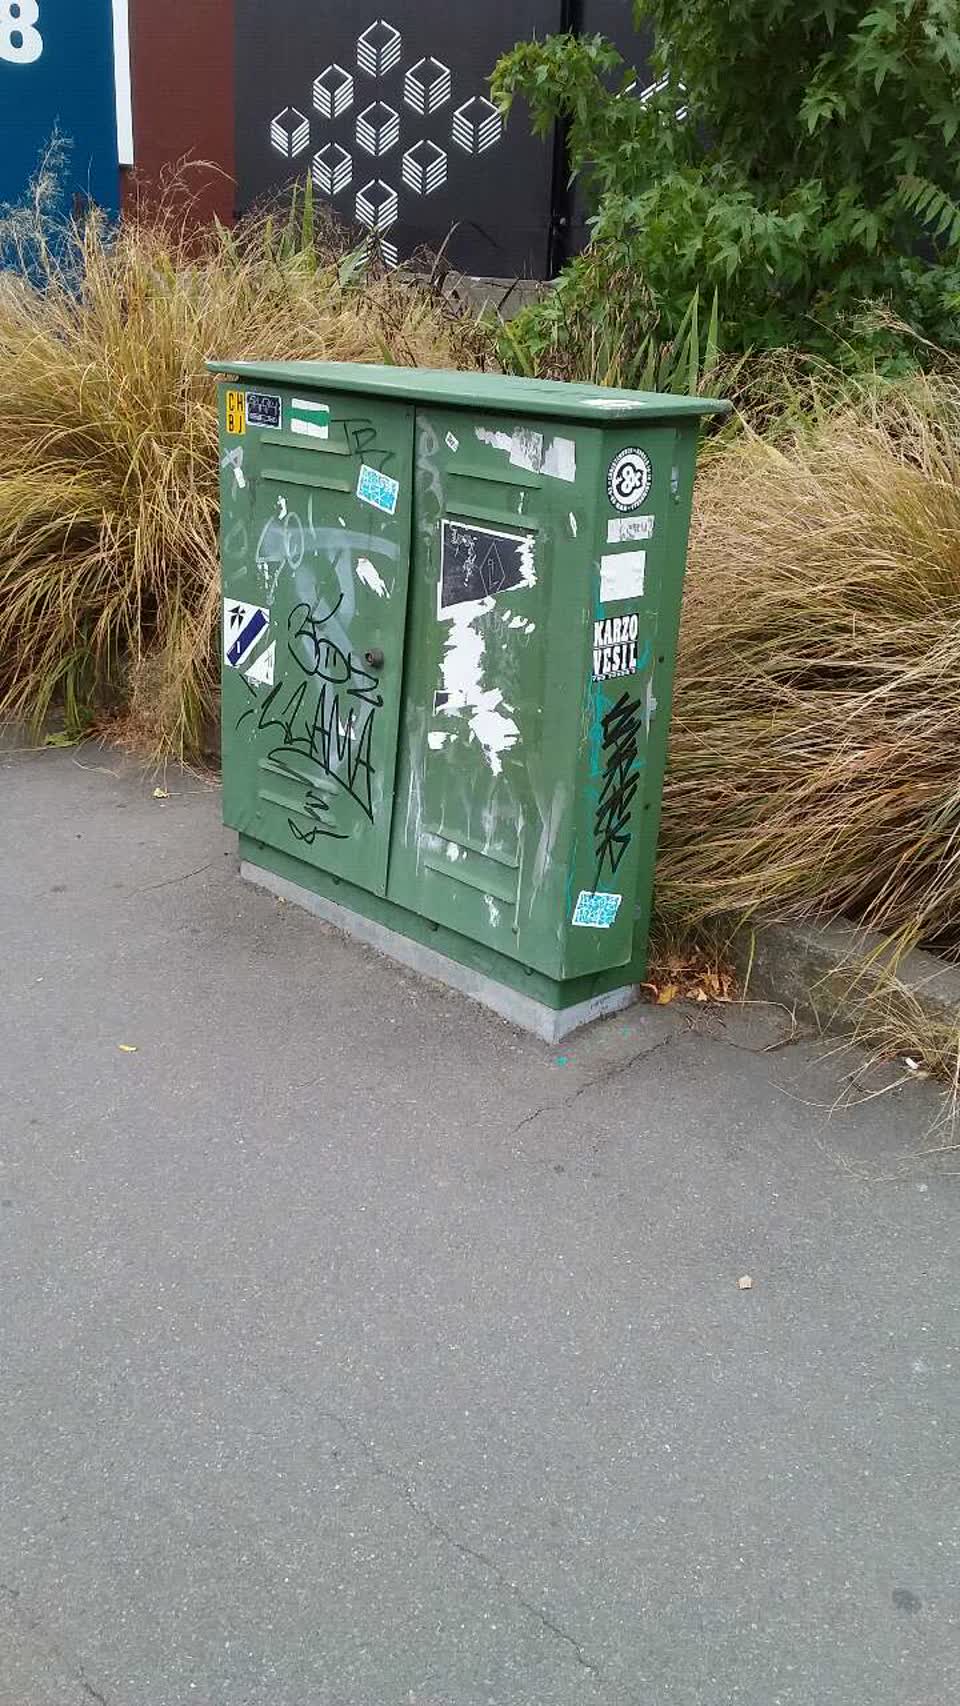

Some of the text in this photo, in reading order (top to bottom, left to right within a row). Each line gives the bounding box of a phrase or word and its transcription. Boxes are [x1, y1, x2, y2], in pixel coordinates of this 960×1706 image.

[0, 0, 43, 64] 8
[228, 392, 244, 412] CH
[593, 613, 639, 647] KARZO
[592, 644, 638, 676] VESIL
